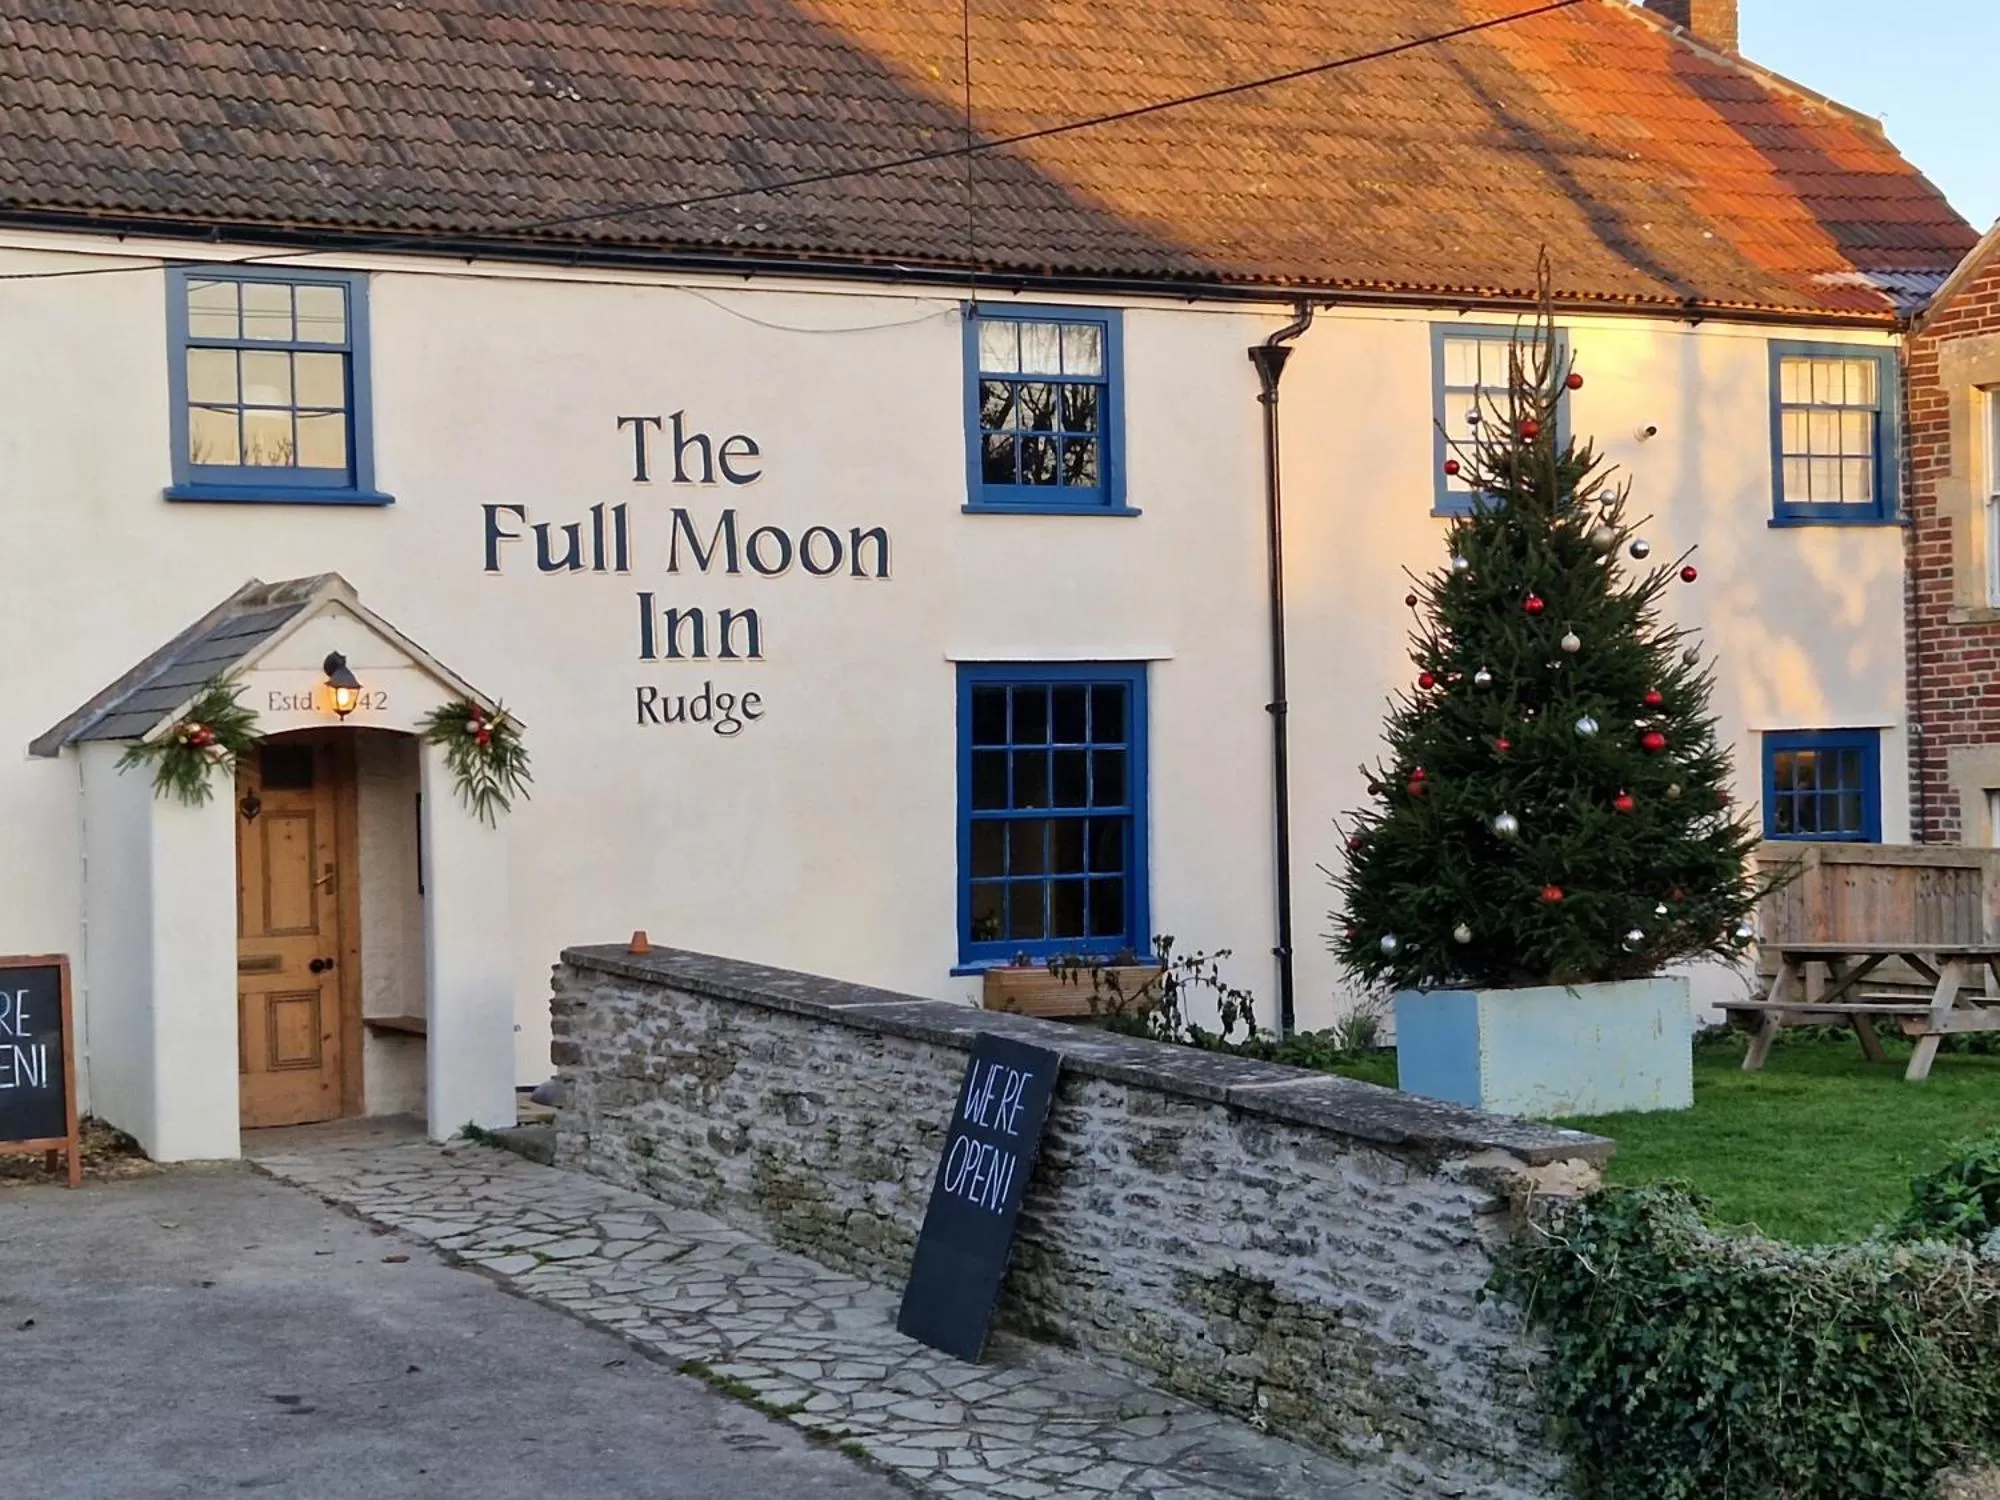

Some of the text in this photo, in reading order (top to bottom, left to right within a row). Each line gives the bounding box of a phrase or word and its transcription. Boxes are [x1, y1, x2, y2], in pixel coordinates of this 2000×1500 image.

[617, 410, 762, 485] The
[481, 502, 892, 578] Full Moon
[637, 592, 763, 660] Inn
[268, 691, 321, 711] Estd.
[636, 681, 763, 735] Rudge
[963, 1058, 1033, 1135] WE'RE
[944, 1135, 1017, 1215] OPEN!
